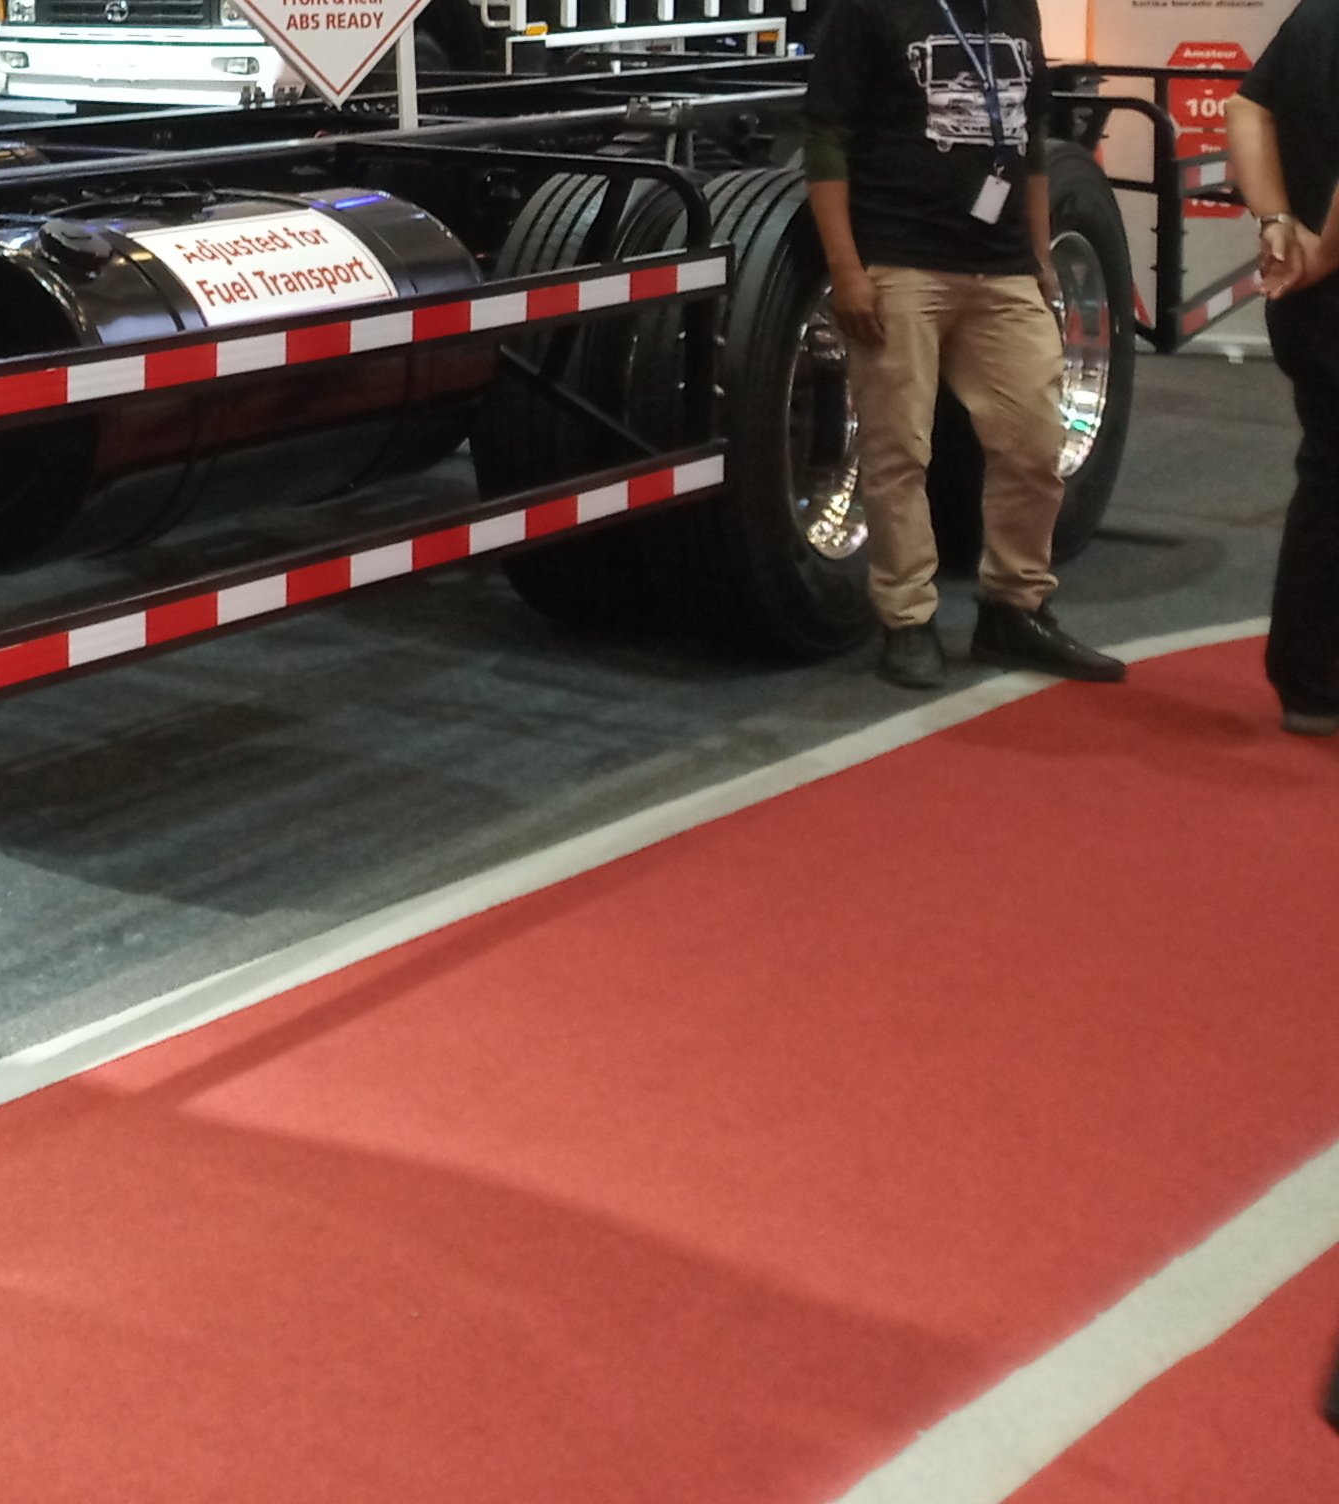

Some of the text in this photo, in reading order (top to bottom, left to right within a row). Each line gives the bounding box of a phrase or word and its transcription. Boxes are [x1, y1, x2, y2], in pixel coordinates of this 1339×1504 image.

[286, 12, 384, 31] ABS READY
[1183, 48, 1238, 59] Amateur
[175, 226, 329, 265] Adjusted for
[196, 256, 374, 307] Fuel Transport
